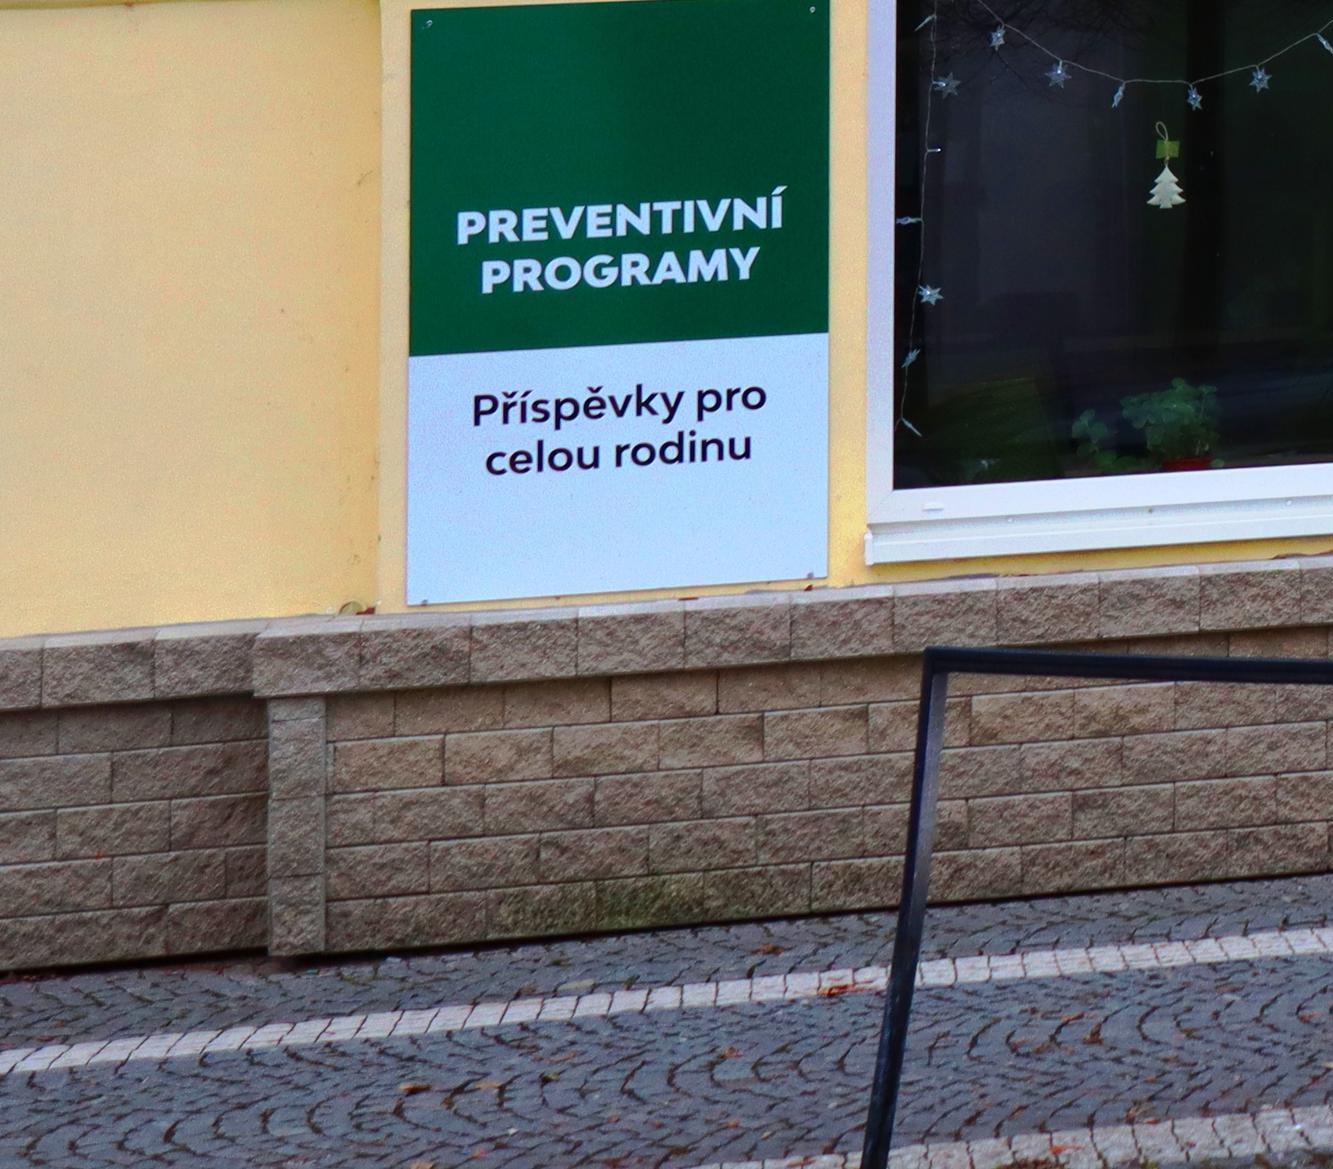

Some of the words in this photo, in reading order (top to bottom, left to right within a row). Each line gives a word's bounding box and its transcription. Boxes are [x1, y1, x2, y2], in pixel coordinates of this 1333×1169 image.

[456, 185, 788, 245] PREVENTIVNÍ
[480, 246, 760, 294] PROGRAMY
[472, 382, 685, 430] Příspěvky
[696, 385, 767, 421] pro
[485, 438, 599, 475] celou
[614, 430, 752, 469] rodinu
